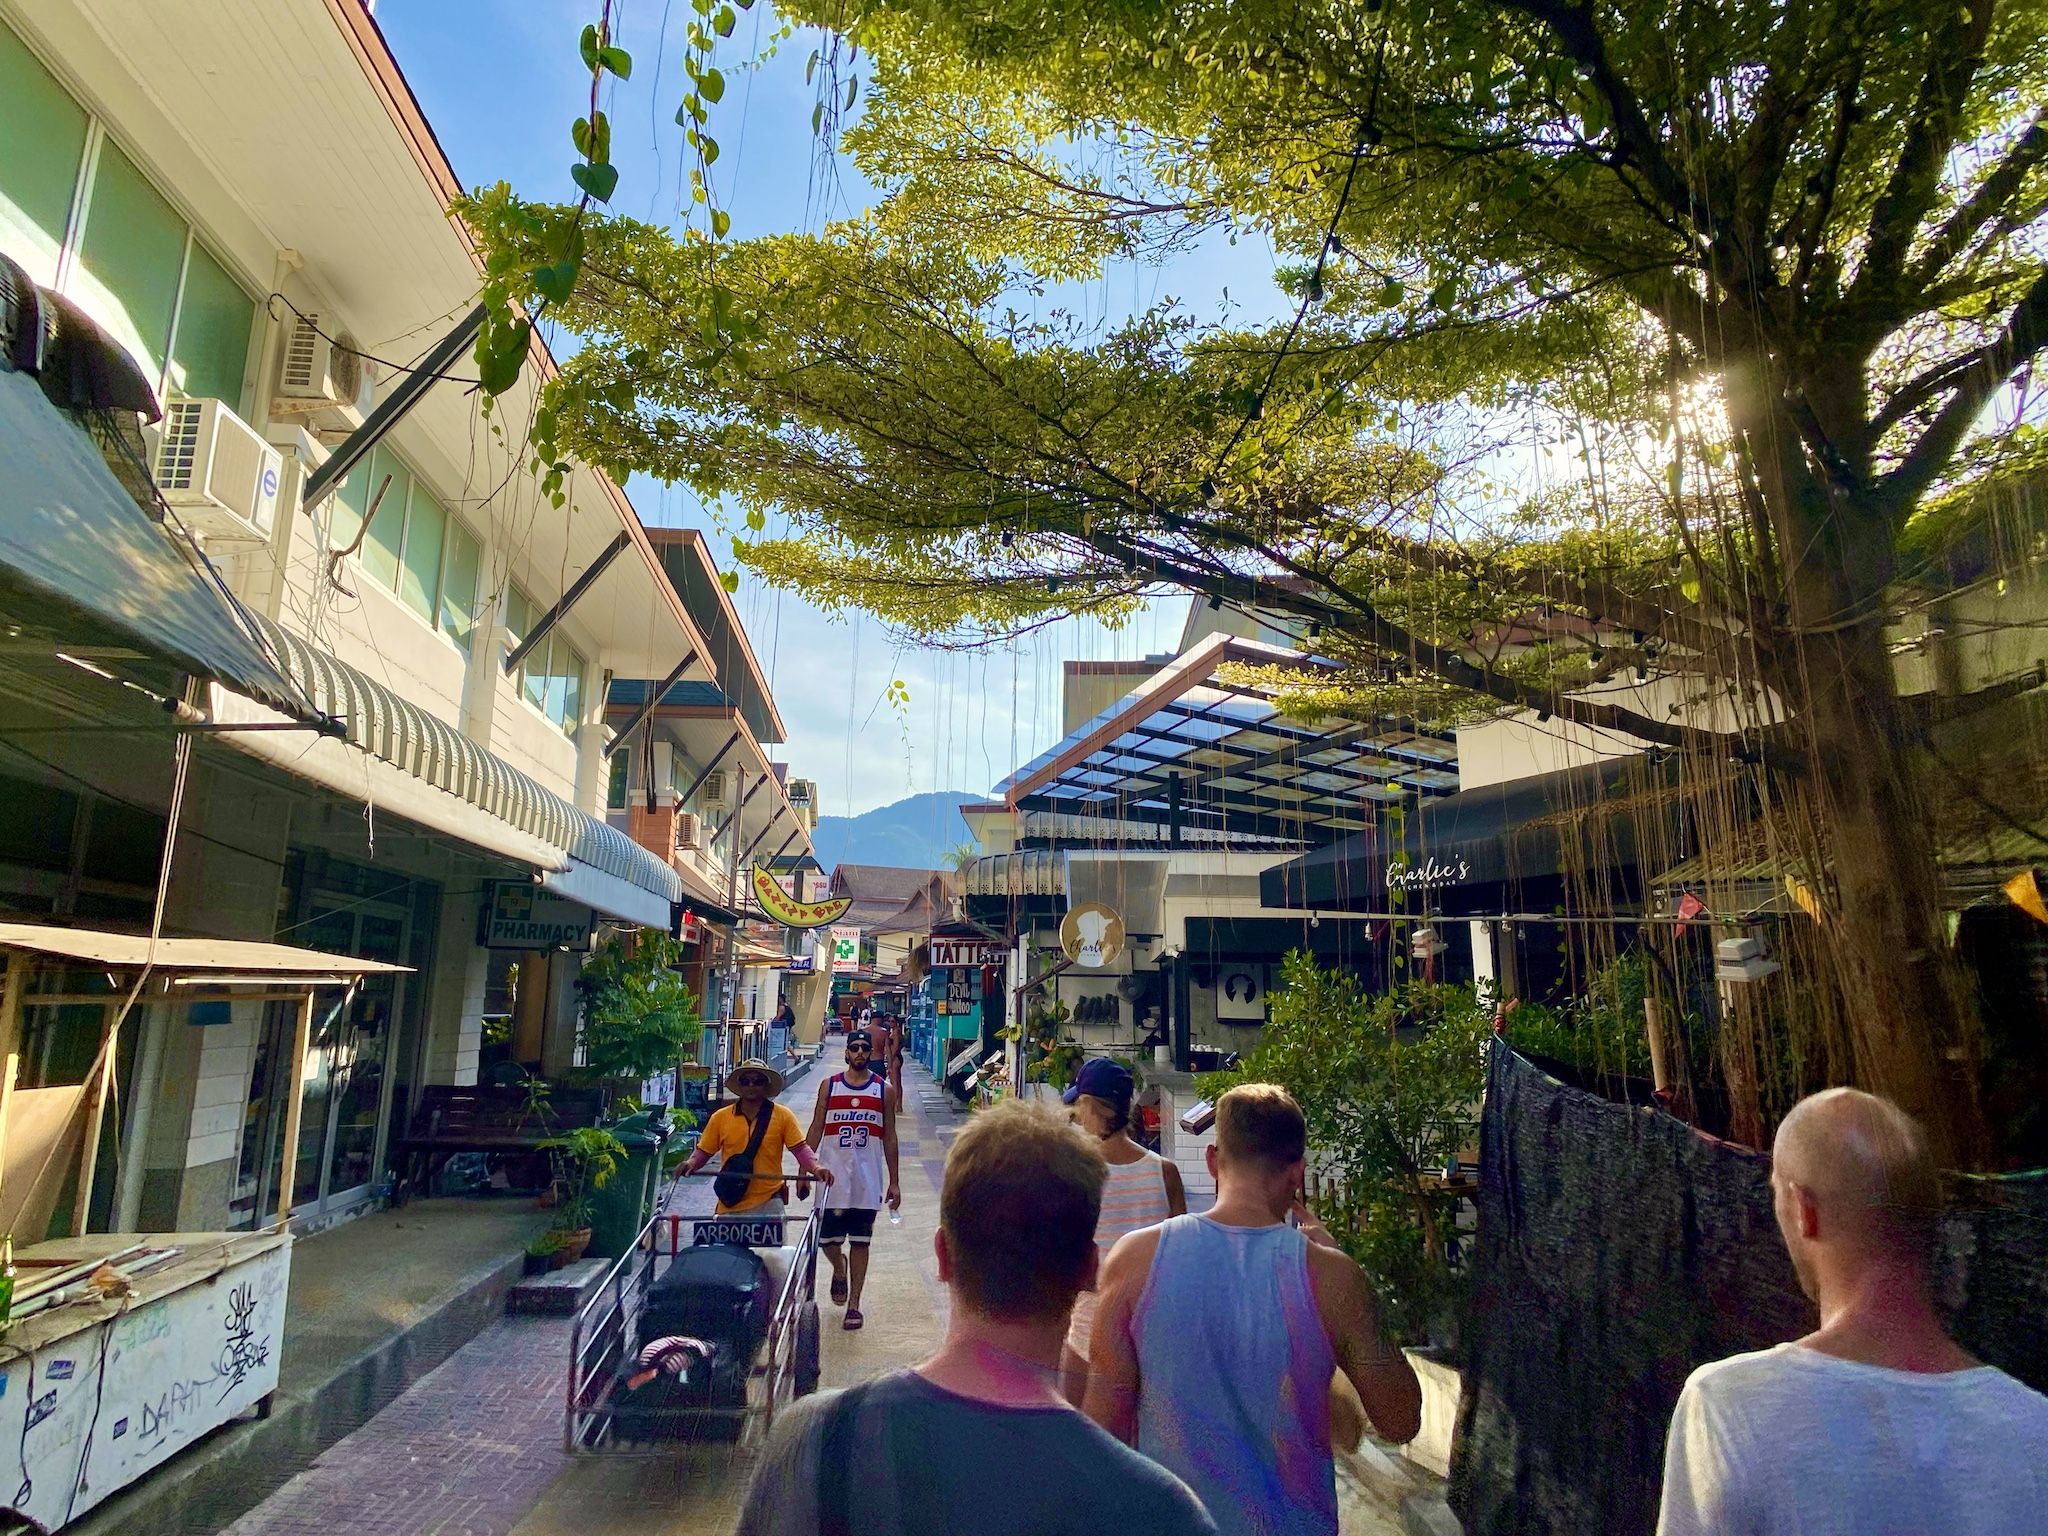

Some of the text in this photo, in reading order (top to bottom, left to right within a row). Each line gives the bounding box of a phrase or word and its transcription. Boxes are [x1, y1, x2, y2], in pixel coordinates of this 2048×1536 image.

[813, 901, 842, 918] BAR
[493, 921, 587, 941] PHARMACY
[833, 929, 859, 937] Siam
[948, 983, 970, 998] DEVIL
[834, 1111, 876, 1121] bullets
[839, 1126, 869, 1149] 23
[694, 1224, 780, 1245] ARBOREAL
